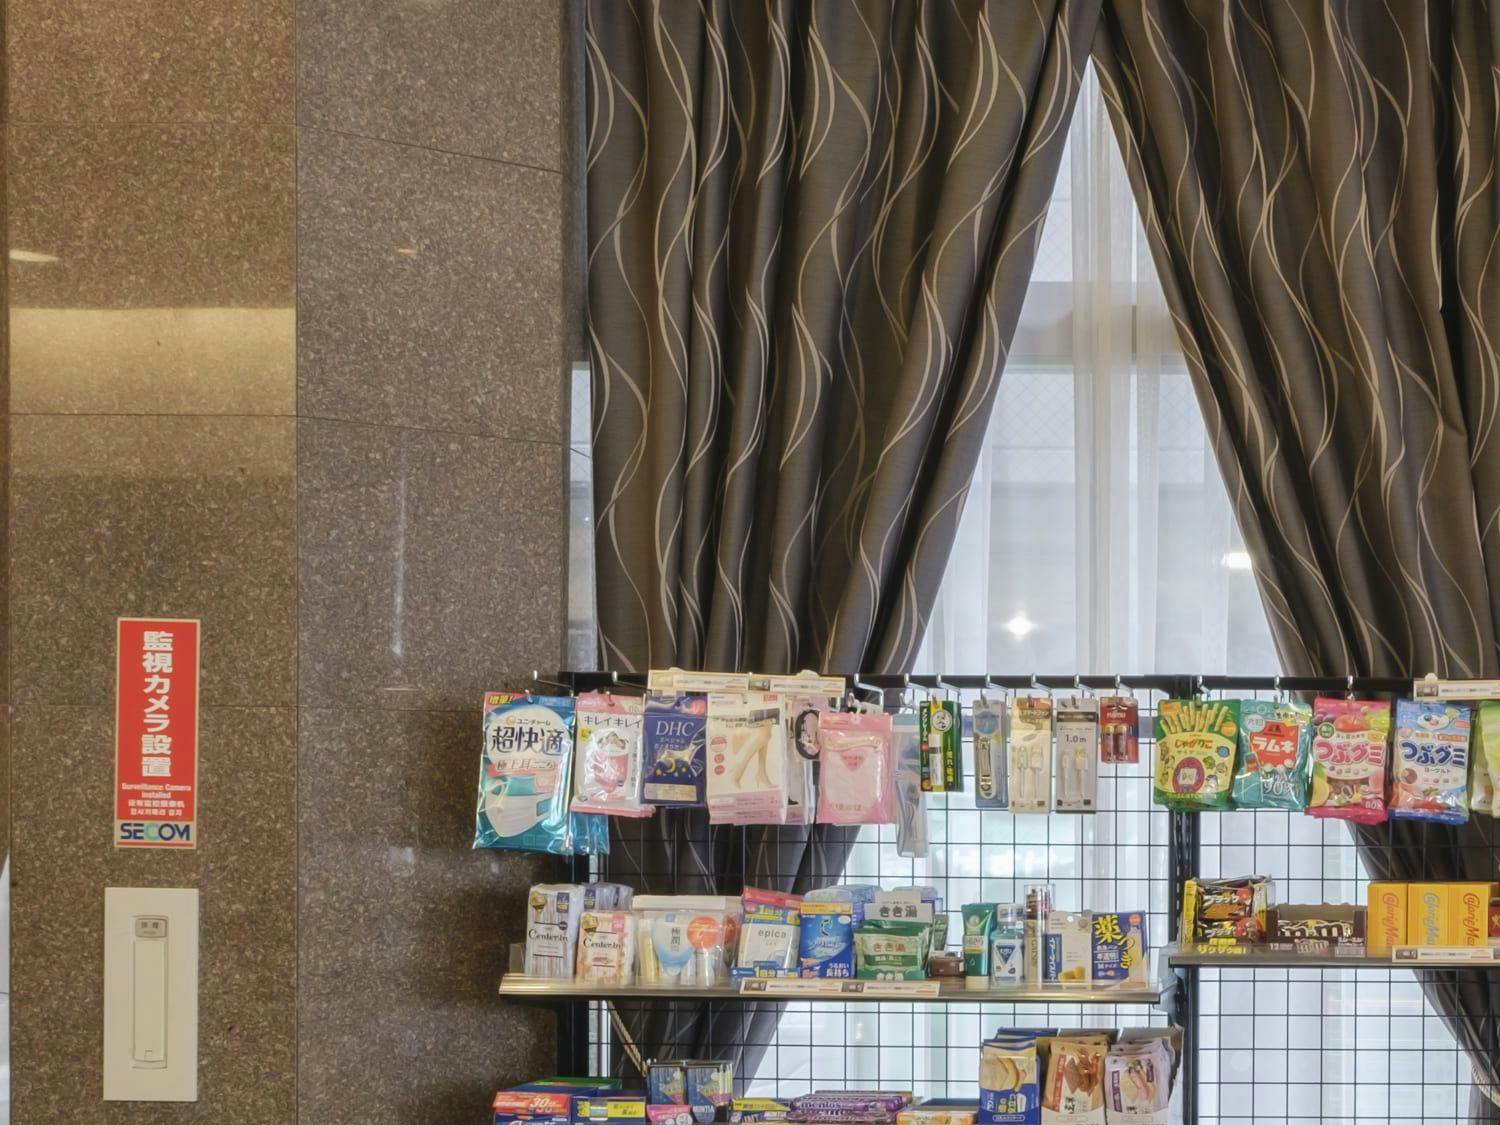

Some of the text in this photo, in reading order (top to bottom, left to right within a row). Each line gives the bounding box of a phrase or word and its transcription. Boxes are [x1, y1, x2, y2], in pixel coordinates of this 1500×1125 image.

[142, 631, 174, 777] 監視カメラ設置
[583, 715, 643, 727] キレイキレイ
[655, 720, 695, 737] DHC
[491, 726, 565, 755] 超快適
[1252, 736, 1295, 755] ラムネ
[1314, 739, 1385, 766] つぶグミ
[1399, 740, 1467, 766] つぶグミ
[141, 791, 171, 799] Installed
[165, 783, 191, 792] Camera
[120, 822, 190, 841] SECOM
[878, 905, 918, 918] きき湯
[757, 927, 787, 939] epica
[801, 1101, 841, 1110] mentos
